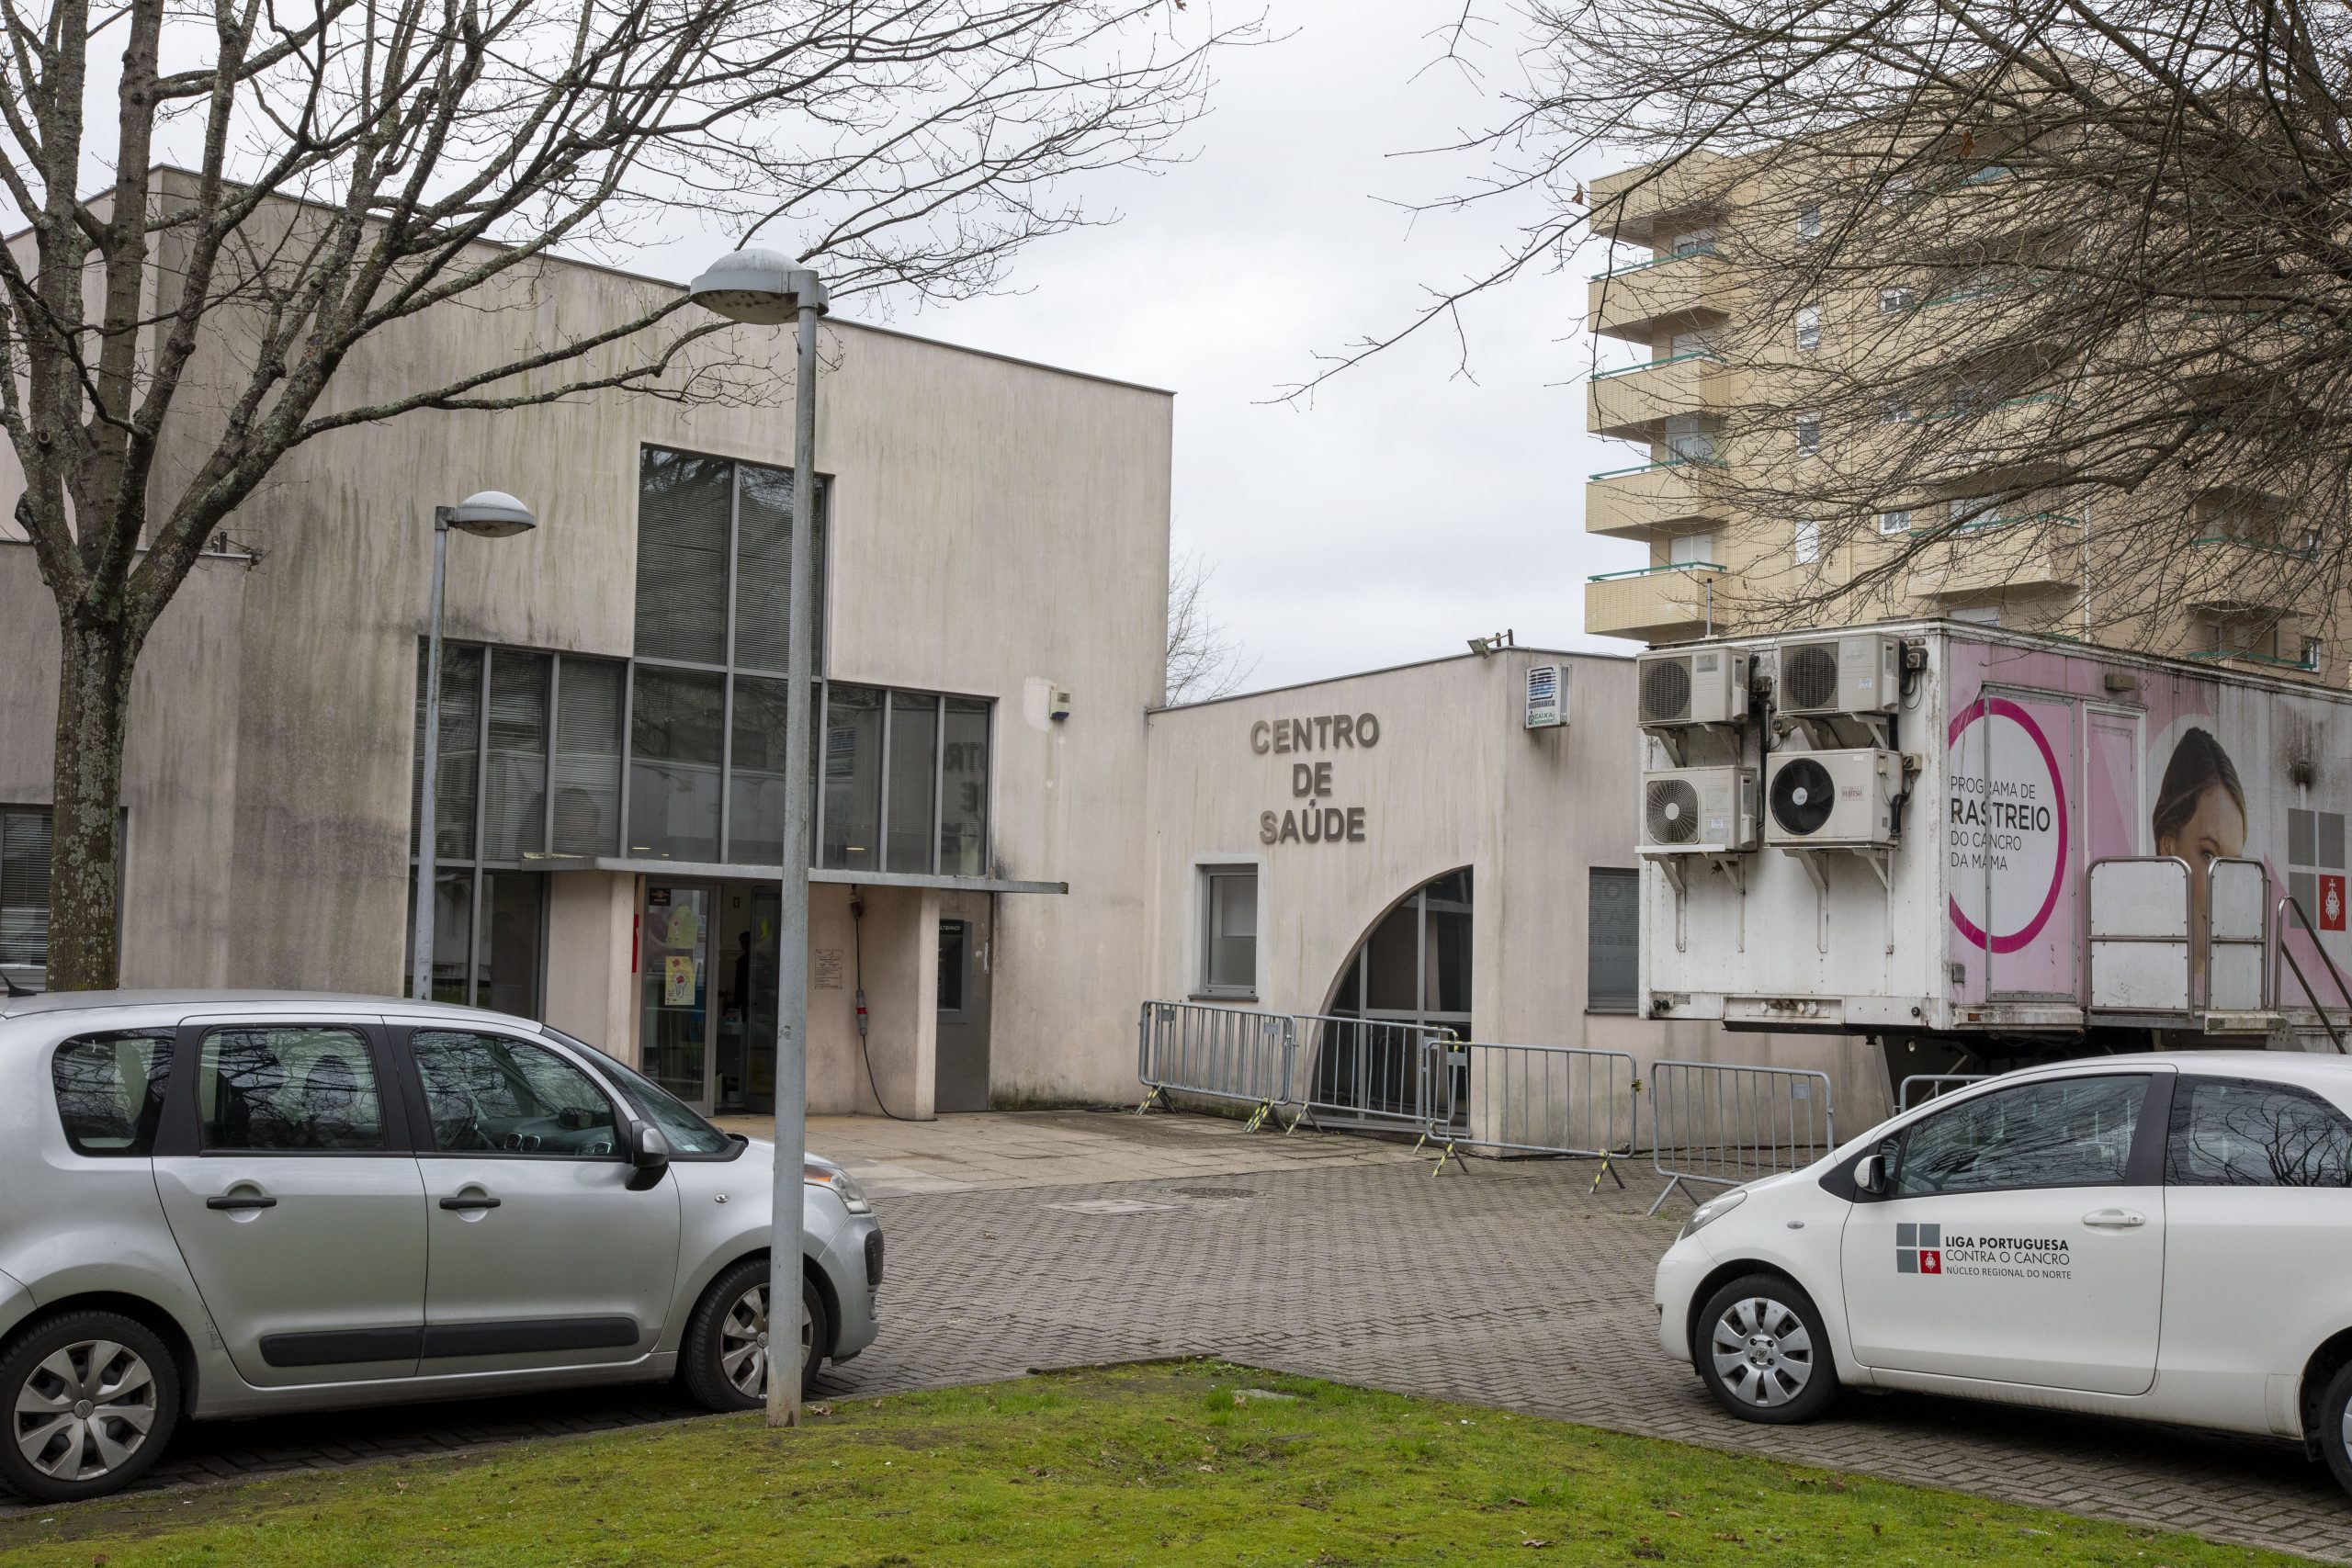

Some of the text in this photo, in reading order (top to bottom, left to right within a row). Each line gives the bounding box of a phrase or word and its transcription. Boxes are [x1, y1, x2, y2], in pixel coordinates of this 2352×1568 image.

[1250, 713, 1380, 754] CENTRO
[1293, 762, 1332, 796] DE
[1951, 776, 2036, 799] PROGAMA DE
[1842, 786, 1862, 798] FUJITSU
[1260, 799, 1365, 844] SAÚDE
[1951, 798, 2051, 832] RASTREIO
[1951, 830, 2021, 851] DO CANCRO
[1951, 852, 2007, 871] DA MAMA
[1946, 1236, 2069, 1250] LIGA PORTUGUESA
[1946, 1249, 2070, 1265] CONTRA O CANCRO
[1946, 1265, 2072, 1280] NÚCLEO REGIONAL DO NORTE
